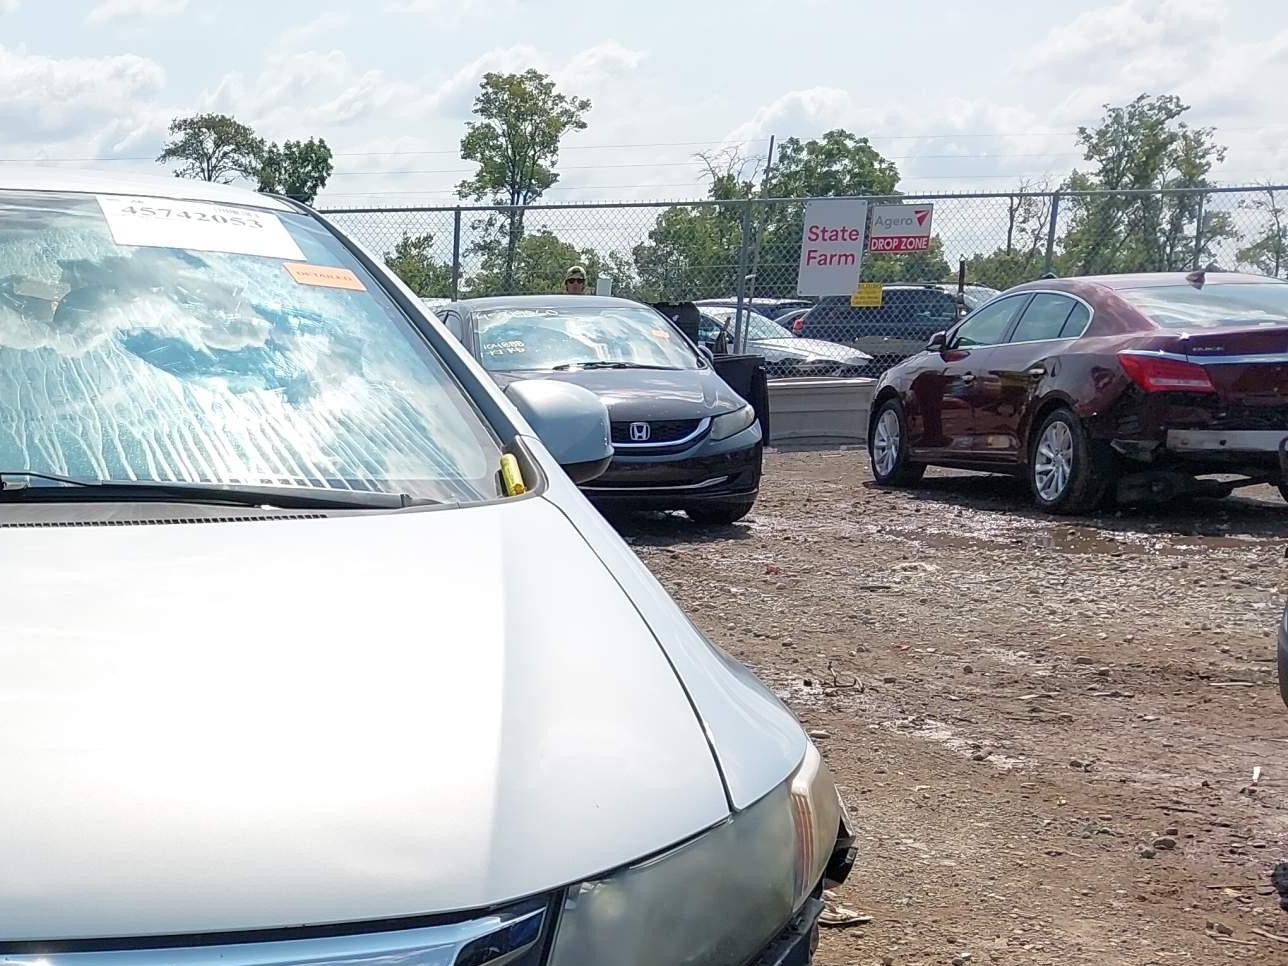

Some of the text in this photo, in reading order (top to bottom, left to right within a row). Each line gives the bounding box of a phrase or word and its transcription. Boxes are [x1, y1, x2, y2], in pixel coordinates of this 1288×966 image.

[121, 205, 264, 229] 45742053
[874, 215, 913, 229] Agero
[807, 225, 860, 242] State
[871, 237, 928, 250] DROP ZONE
[806, 250, 856, 266] Farm
